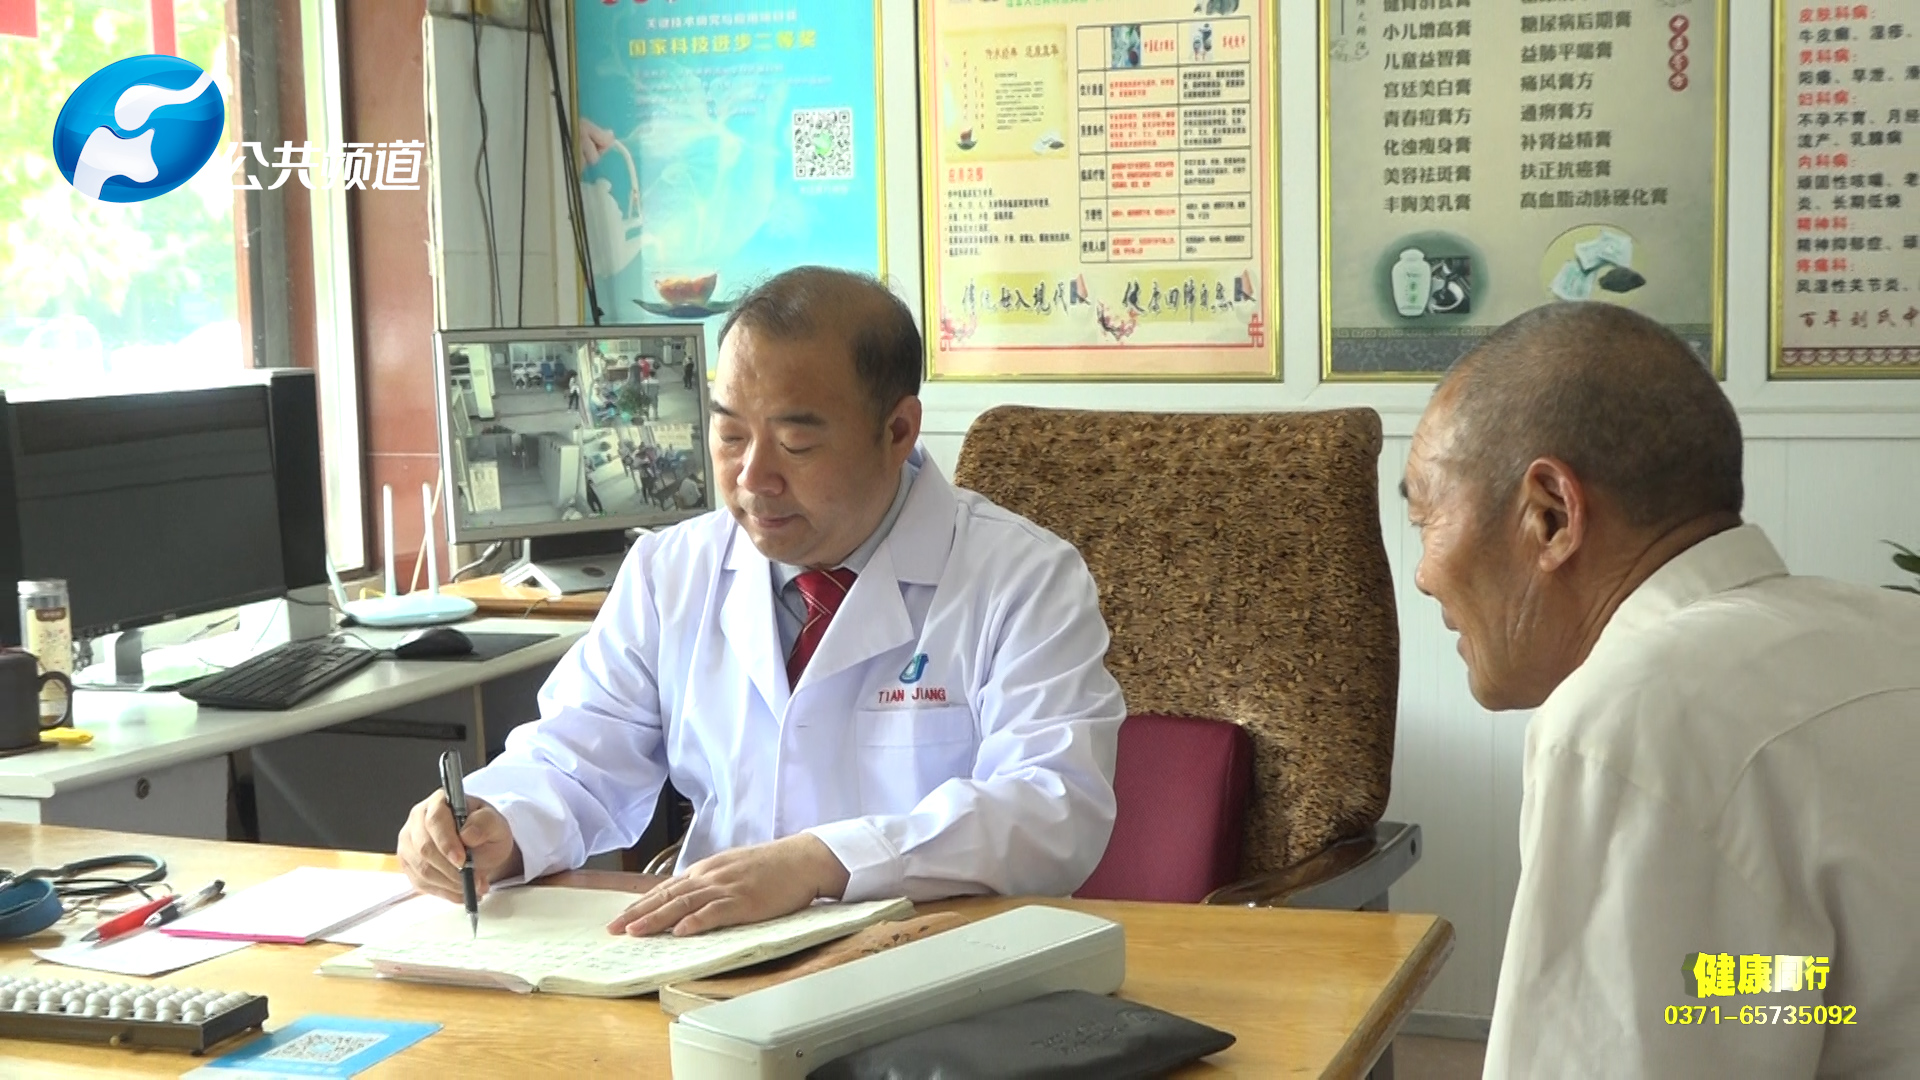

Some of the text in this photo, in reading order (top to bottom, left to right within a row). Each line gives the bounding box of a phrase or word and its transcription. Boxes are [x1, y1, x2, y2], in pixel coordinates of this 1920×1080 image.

[1382, 20, 1471, 40] 小儿增高膏
[1520, 10, 1632, 33] 糖尿病后期膏
[1383, 49, 1471, 70] 儿童益智膏
[1520, 41, 1612, 63] 益肺平喘膏
[1383, 78, 1471, 99] 宫廷美白膏
[1520, 72, 1593, 92] 痛风膏方
[1383, 107, 1471, 128] 青春痘膏方
[1383, 136, 1471, 157] 化浊瘦身膏
[1520, 130, 1612, 151] 补肾益精膏
[1383, 165, 1471, 186] 美容祛斑膏
[1520, 159, 1612, 181] 扶正抗癌膏
[1383, 193, 1471, 214] 丰胸美乳膏
[1520, 187, 1669, 210] 高血脂动脉硬化膏
[878, 687, 947, 703] TIAN JIANG
